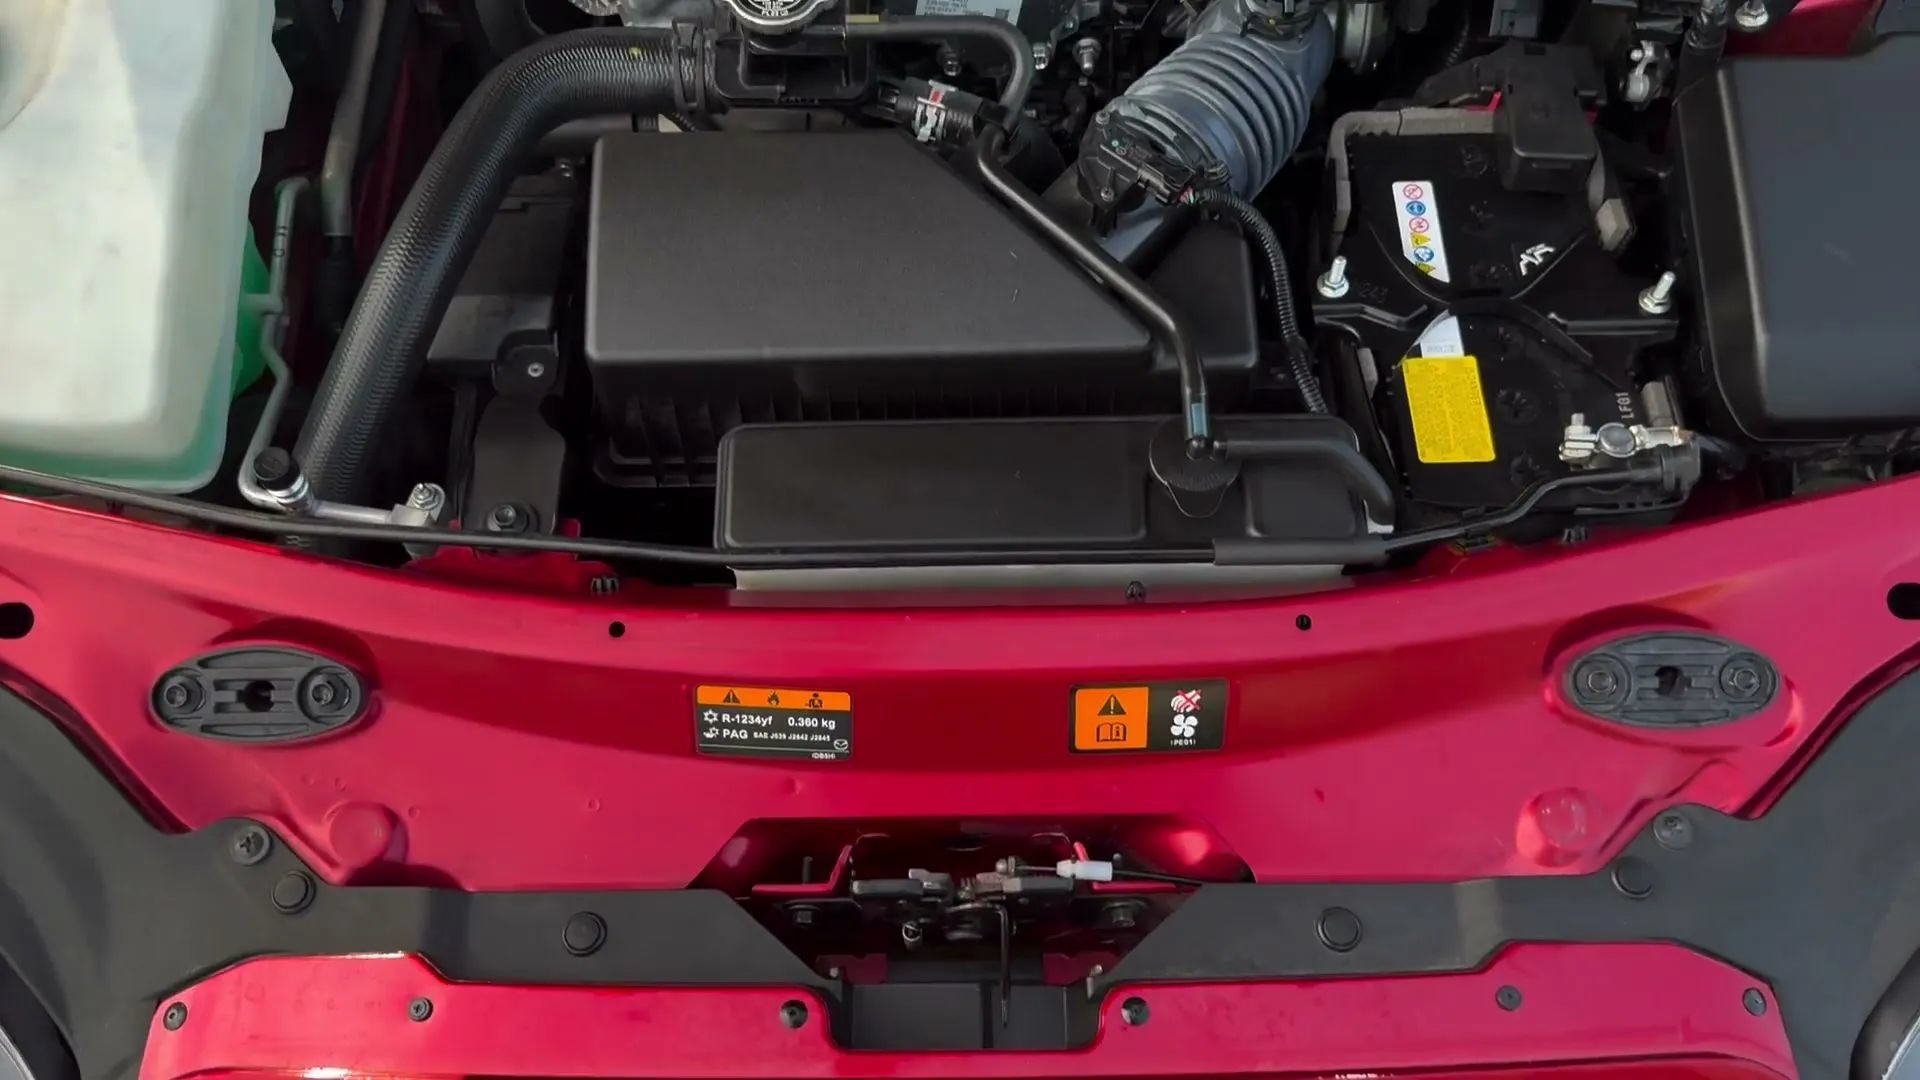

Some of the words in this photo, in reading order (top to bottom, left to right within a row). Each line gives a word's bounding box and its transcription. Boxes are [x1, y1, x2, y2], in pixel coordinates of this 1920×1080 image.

[722, 713, 773, 727] R-1234yf
[821, 717, 836, 731] kg
[722, 728, 749, 740] PAG
